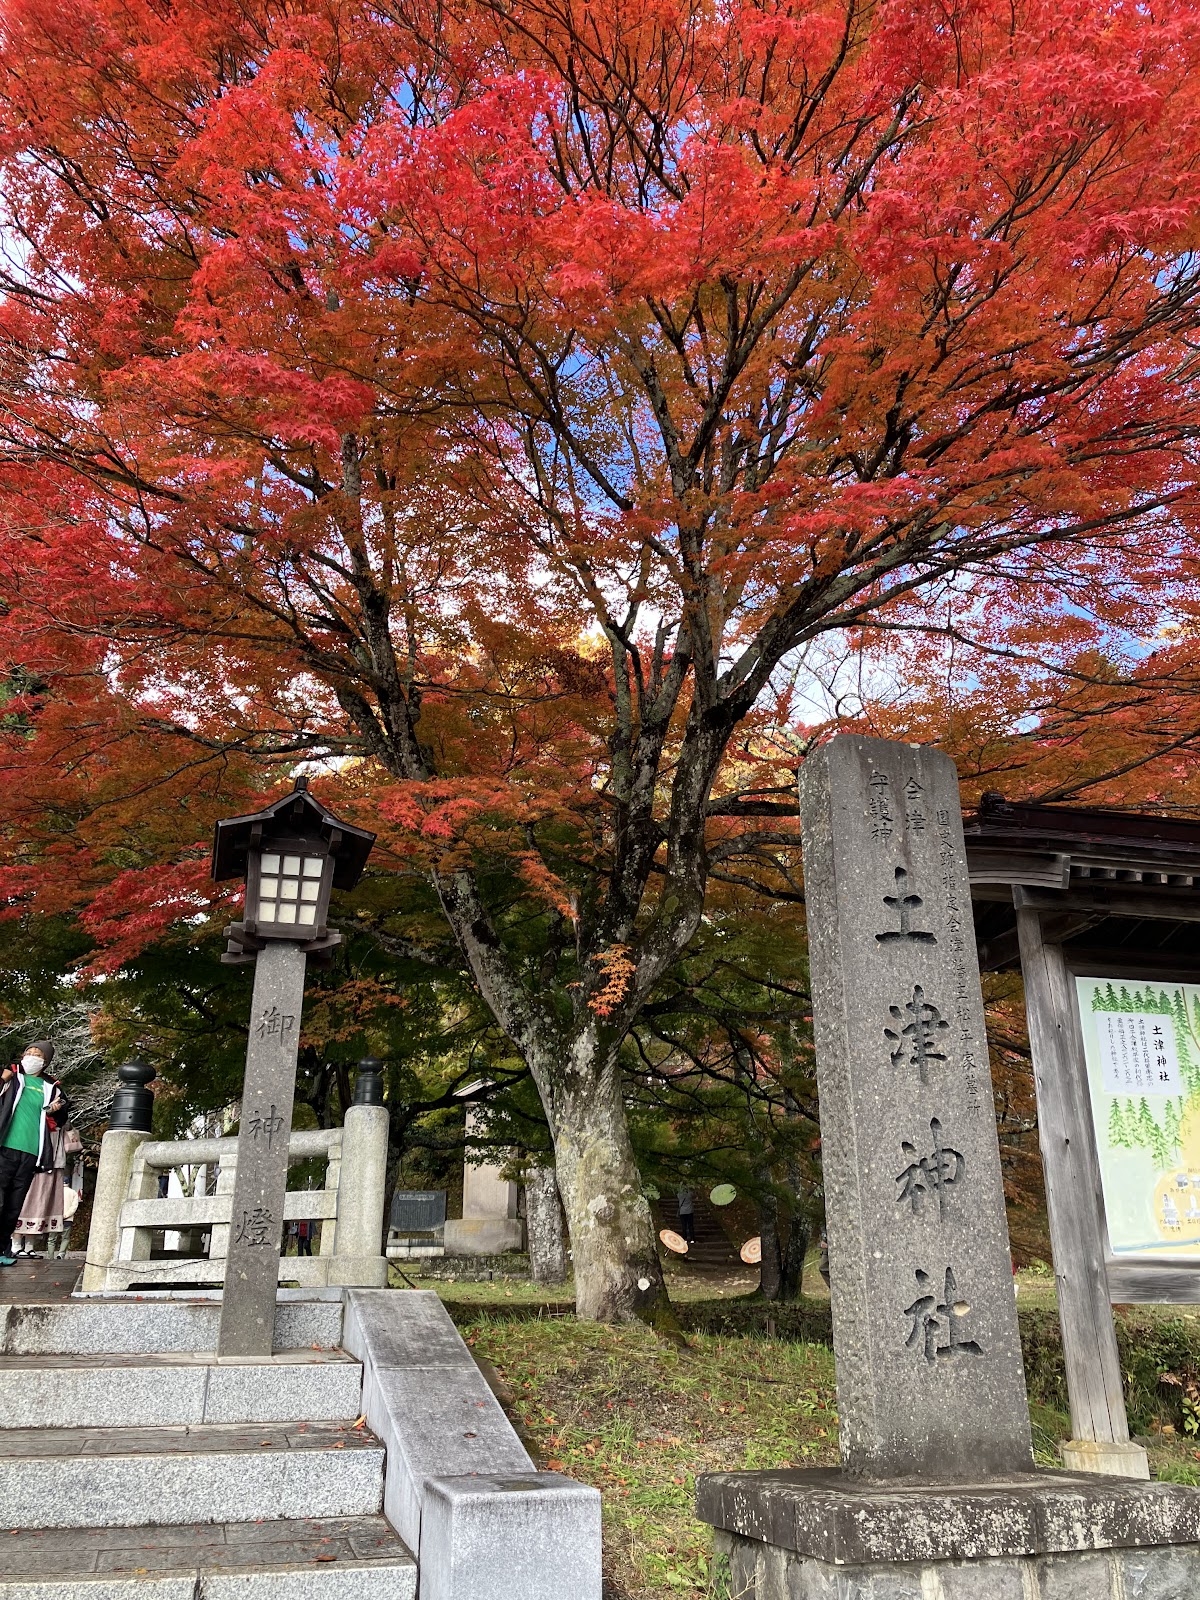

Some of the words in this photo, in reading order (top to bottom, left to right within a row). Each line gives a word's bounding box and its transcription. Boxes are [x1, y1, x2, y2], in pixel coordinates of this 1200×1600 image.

[902, 776, 927, 836] 会津
[1152, 1025, 1170, 1081] 土津神社
[235, 1006, 295, 1248] 御神燈
